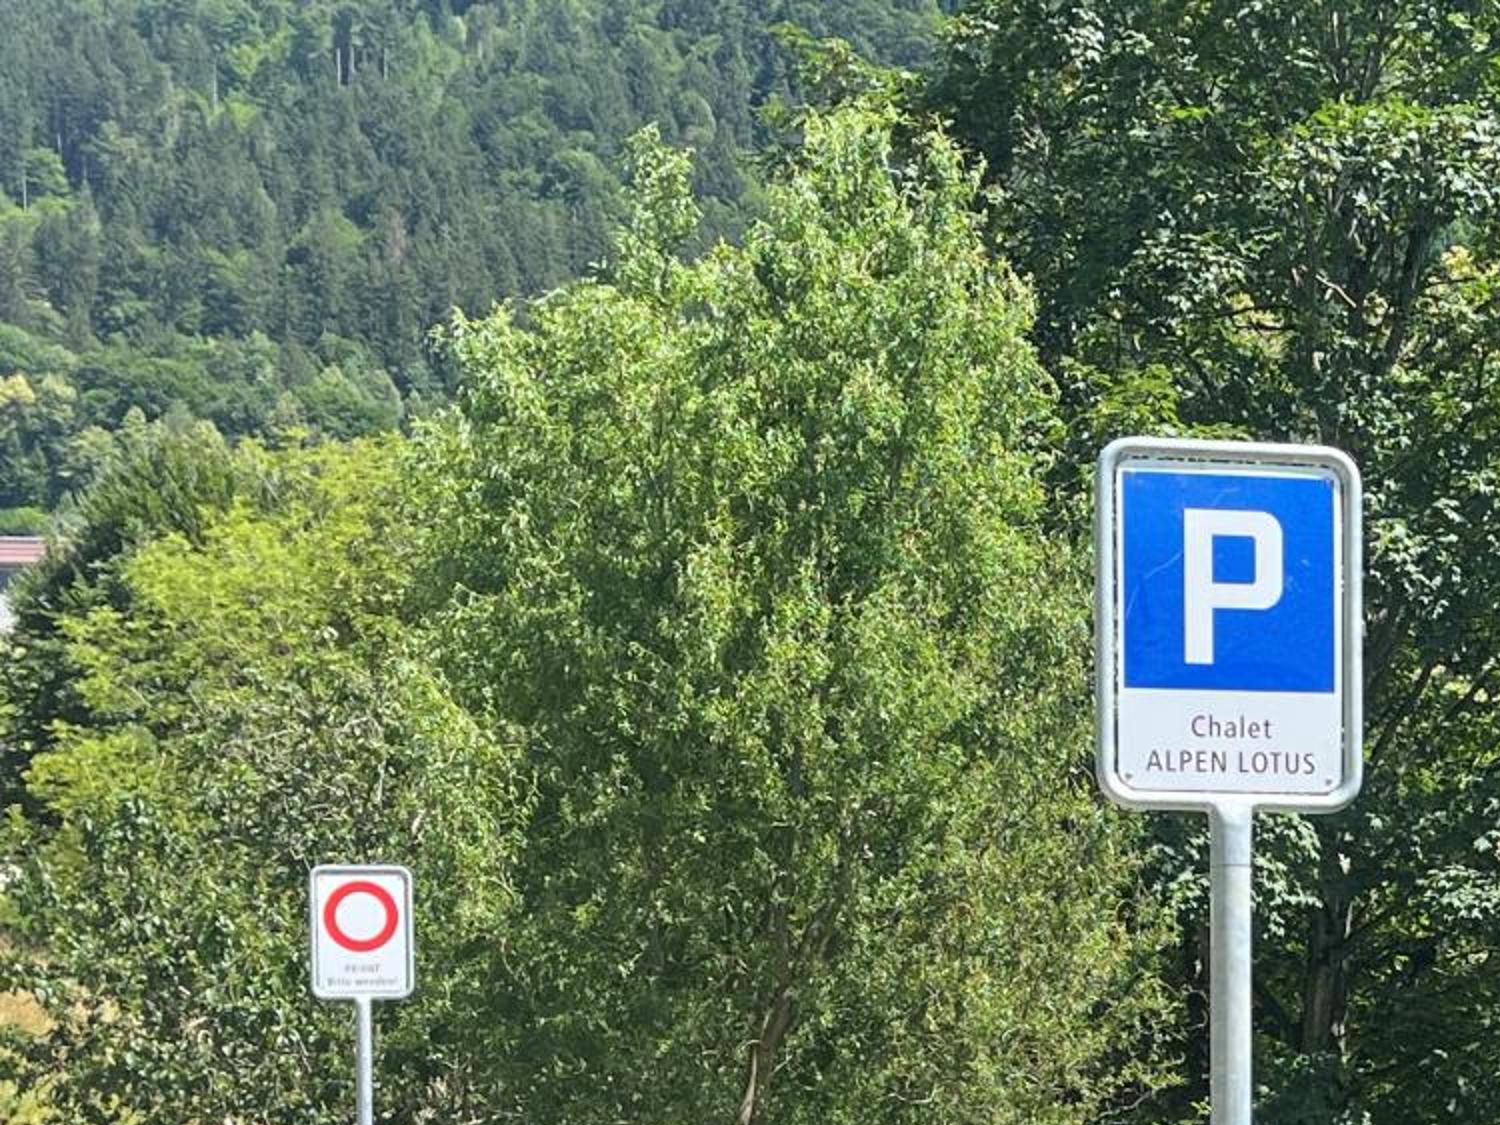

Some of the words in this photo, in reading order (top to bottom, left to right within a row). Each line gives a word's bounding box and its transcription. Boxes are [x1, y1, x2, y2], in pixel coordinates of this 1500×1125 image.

[1183, 507, 1284, 665] P
[1191, 714, 1272, 740] Chalet
[1146, 749, 1227, 773] ALPEN
[1238, 751, 1316, 775] LOTUS
